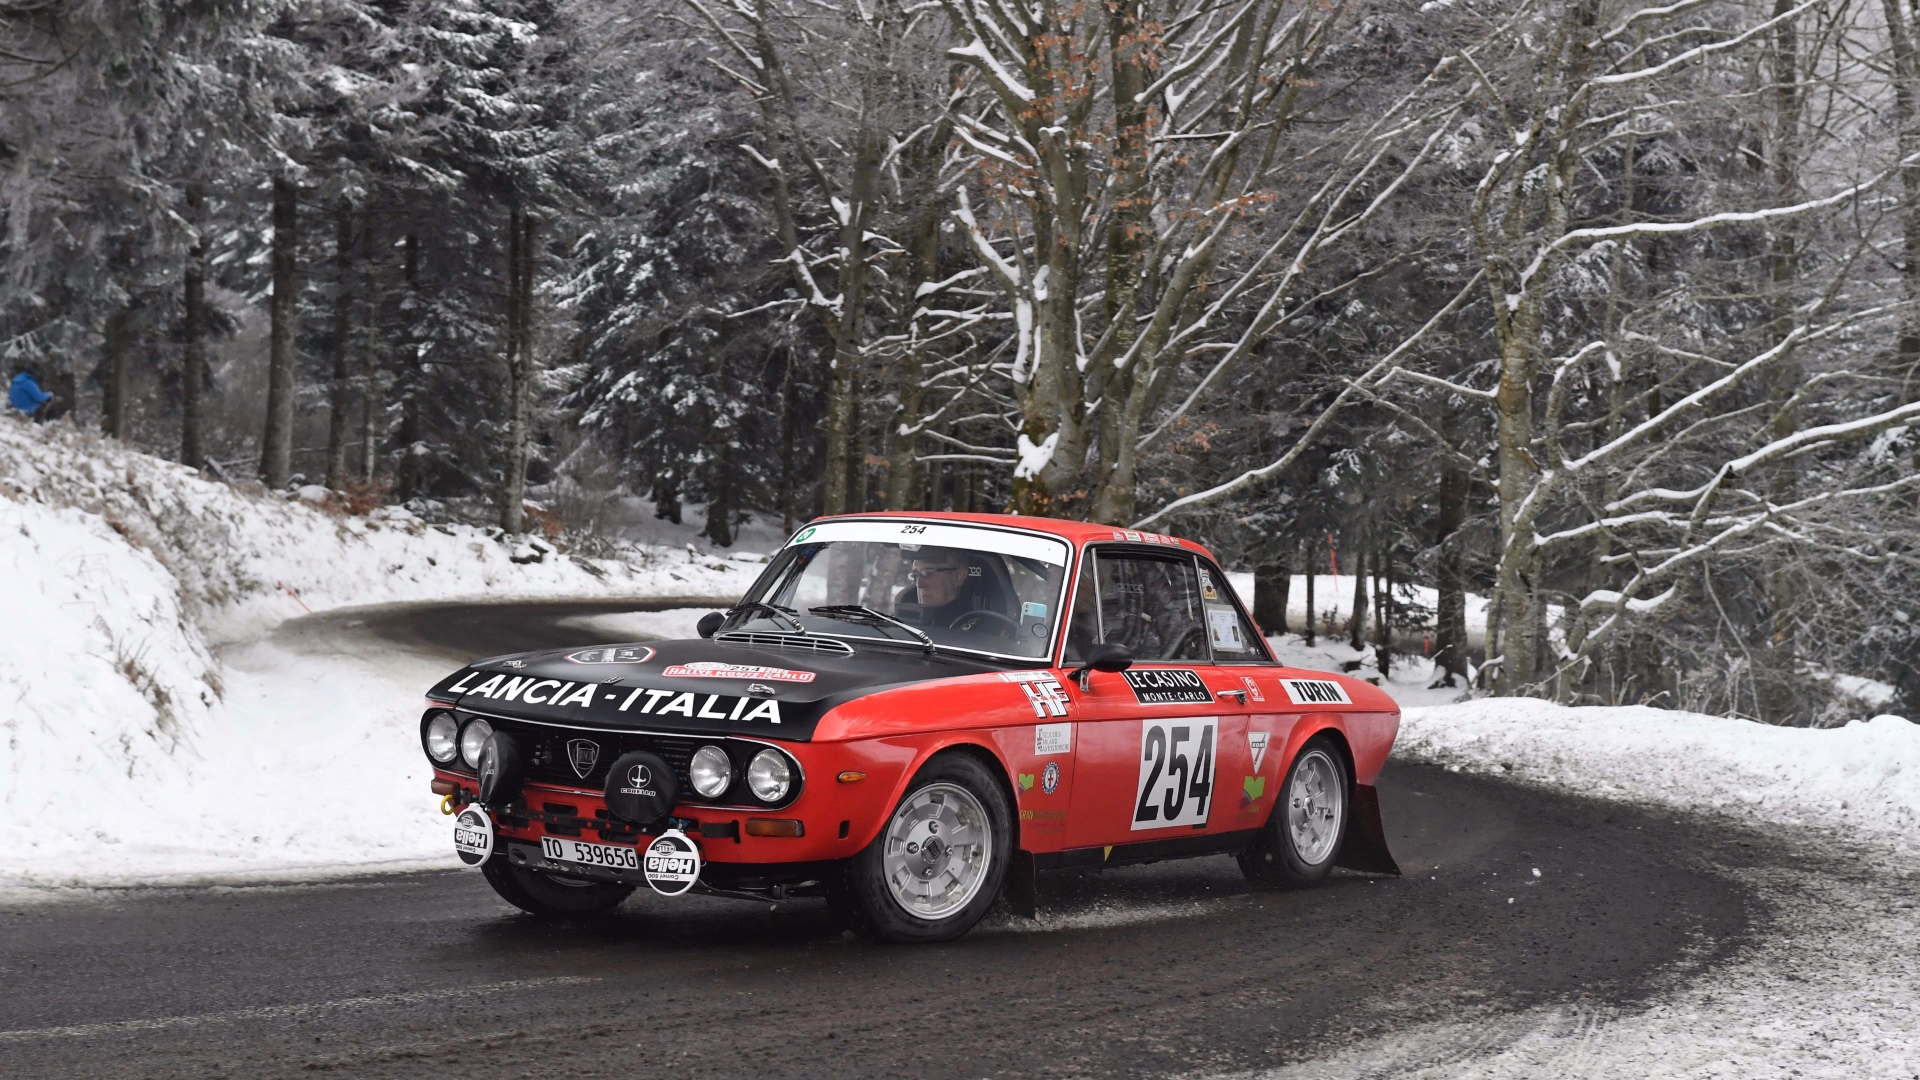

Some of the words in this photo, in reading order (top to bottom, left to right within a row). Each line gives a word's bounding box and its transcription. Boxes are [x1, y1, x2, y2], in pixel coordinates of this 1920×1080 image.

[900, 525, 927, 535] 254
[668, 667, 713, 677] RALLYE
[1124, 670, 1146, 688] LE
[1142, 670, 1200, 688] CASINO
[447, 671, 592, 708] LANCIA
[618, 689, 782, 724] ITALIA
[1019, 680, 1070, 718] HF
[1289, 681, 1343, 702] TURIN
[1135, 724, 1214, 822] 254
[455, 829, 486, 848] Hella
[543, 838, 564, 858] TO
[574, 843, 637, 869] 53965G
[648, 857, 693, 874] Hella
